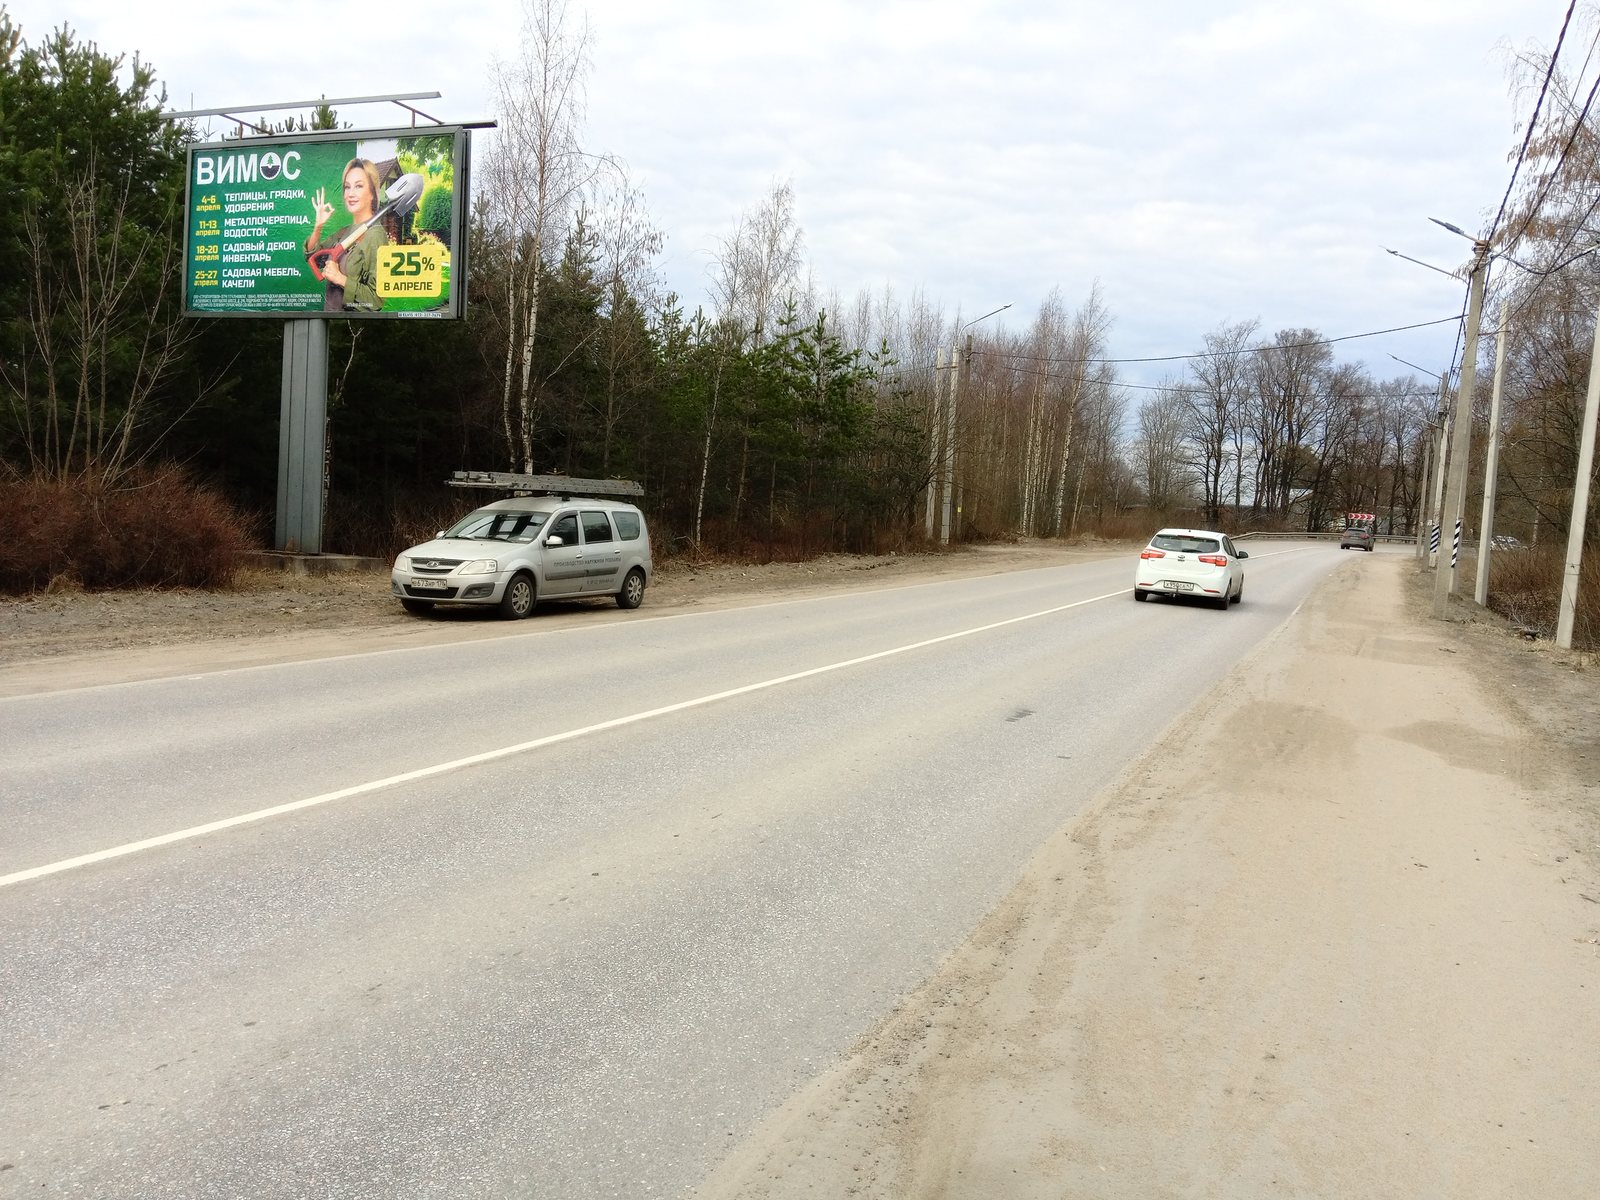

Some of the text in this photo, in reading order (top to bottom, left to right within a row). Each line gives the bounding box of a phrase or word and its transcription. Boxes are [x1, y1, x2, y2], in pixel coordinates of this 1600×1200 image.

[196, 151, 301, 185] ВИМОС
[201, 195, 216, 205] 4-6
[225, 189, 306, 202] ТЕПЛИЦЫ, ГРЯДКИ,
[225, 202, 275, 213] УДОБРЕНИЯ
[199, 220, 217, 229] 11-13
[224, 215, 311, 227] МЕТАЛЛОЧЕРЕПИЦА,
[195, 229, 220, 237] апреля
[224, 228, 268, 239] ВОДОСТОК
[196, 245, 219, 254] 18-20
[223, 241, 296, 253] САДОВЫЙ ДЕКОР,
[195, 254, 220, 262] апреля
[222, 253, 272, 263] ИНВЕНТАРЬ
[383, 251, 435, 276] -25%
[195, 270, 218, 279] 25-27
[222, 267, 302, 278] САДОВАЯ МЕБЕЛЬ,
[222, 279, 255, 288] КАЧЕЛИ
[384, 282, 433, 291] В АПРЕЛЕ
